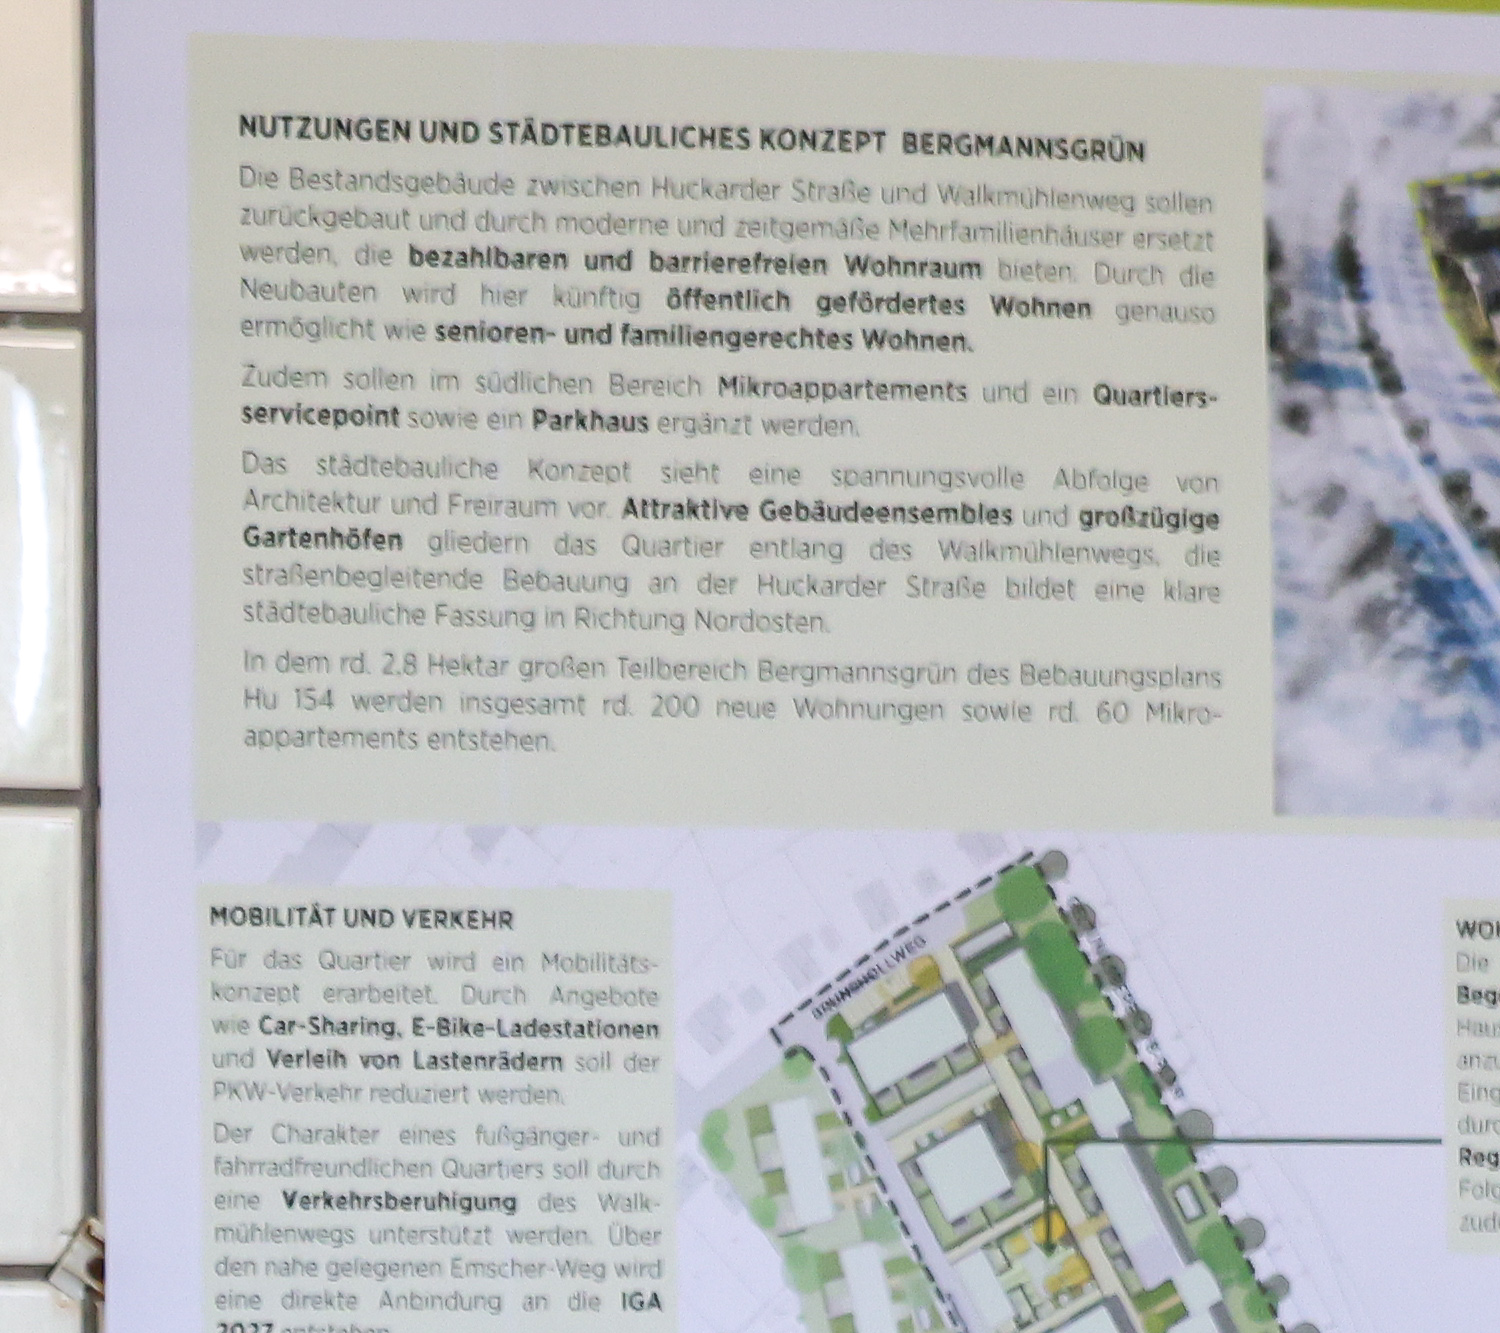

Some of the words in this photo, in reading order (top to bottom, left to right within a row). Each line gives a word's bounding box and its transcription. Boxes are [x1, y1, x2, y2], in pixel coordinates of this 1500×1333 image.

[239, 114, 412, 143] NUTZUNGEN
[419, 120, 480, 144] UND
[488, 117, 751, 151] STÄDTEBAULICHES
[759, 127, 887, 153] KONZEPT
[902, 131, 1146, 163] BERGMANNSGRÜN
[408, 242, 570, 271] bezahlbaren
[583, 247, 634, 273] und
[648, 248, 830, 277] barrierefreien
[843, 252, 985, 281] Wohnraum
[210, 902, 337, 928] MOBILITÄT
[343, 908, 395, 929] UND
[401, 908, 514, 930] VERKEHR
[411, 1014, 661, 1040] E-Bike-Ladestationen
[265, 1046, 349, 1070] Verleih
[358, 1052, 403, 1071] von
[412, 1048, 565, 1073] Lastenrädern
